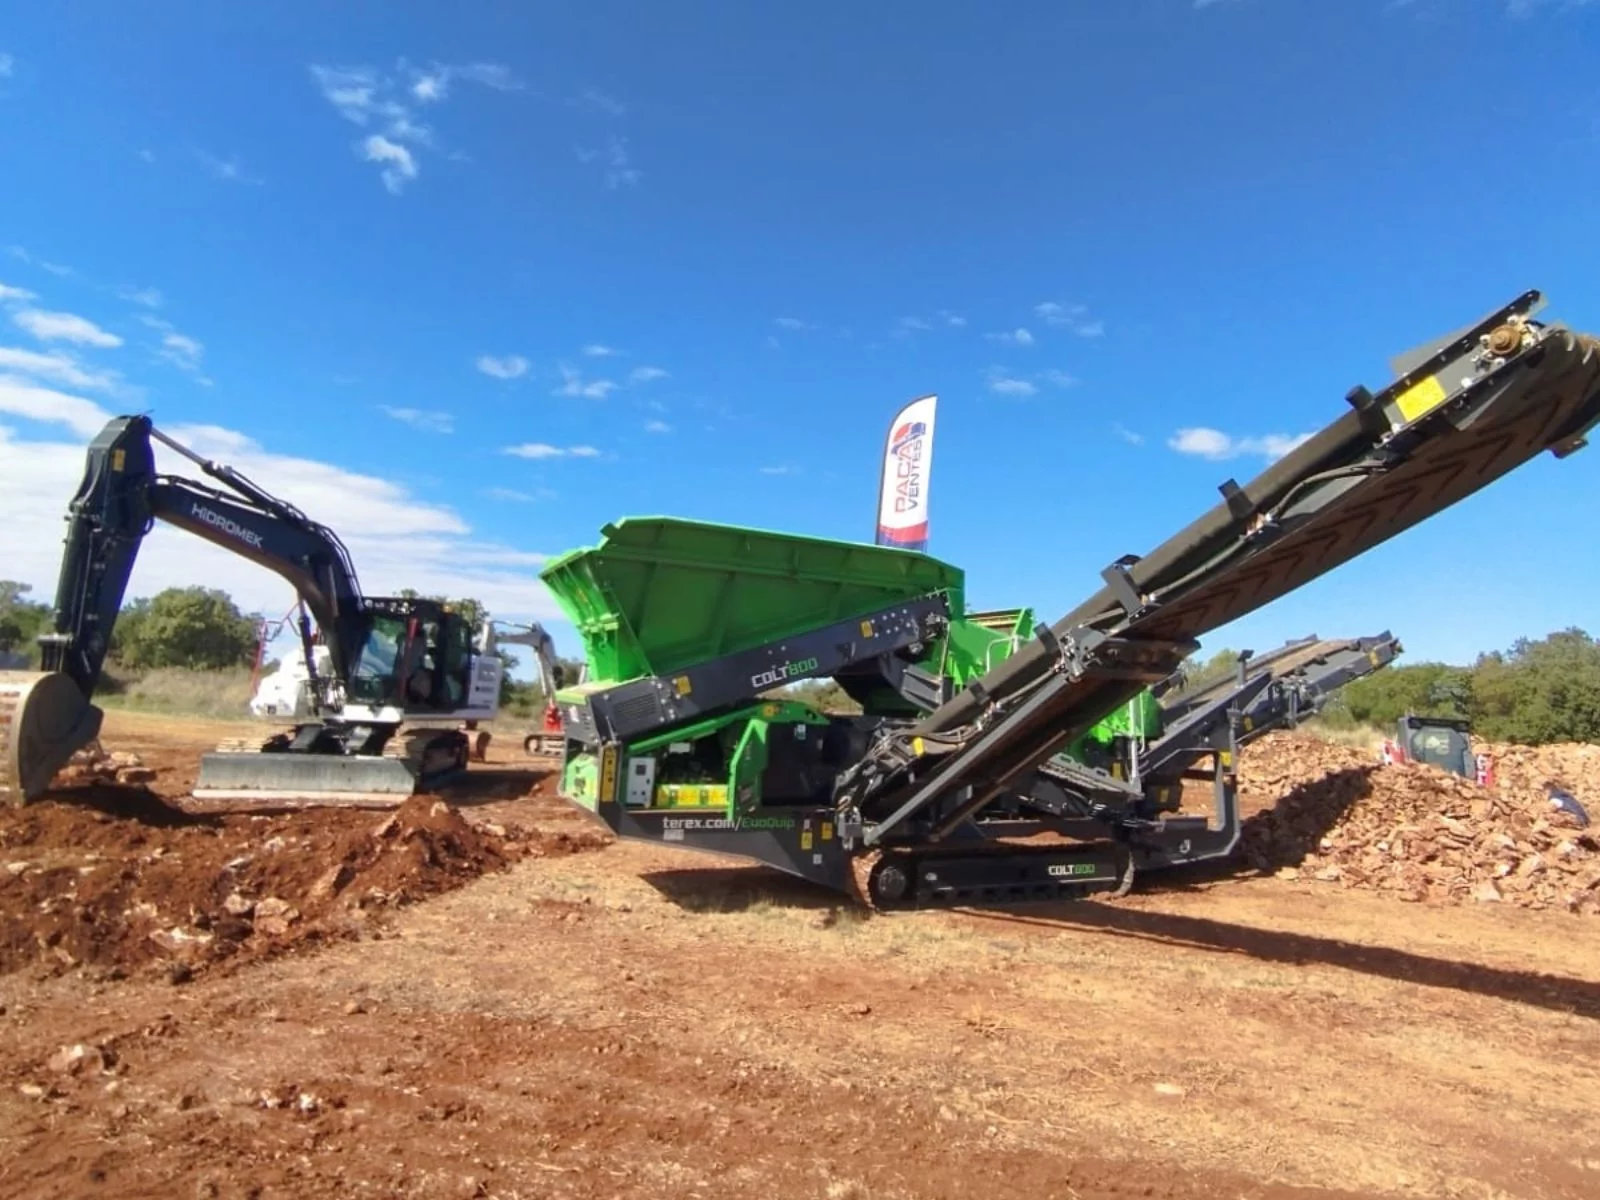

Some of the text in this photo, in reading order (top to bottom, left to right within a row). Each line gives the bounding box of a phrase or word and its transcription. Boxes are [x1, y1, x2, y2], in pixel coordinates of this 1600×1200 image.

[907, 440, 922, 511] VENTES
[191, 502, 263, 548] HIDROMEK
[751, 657, 819, 688] COLT800
